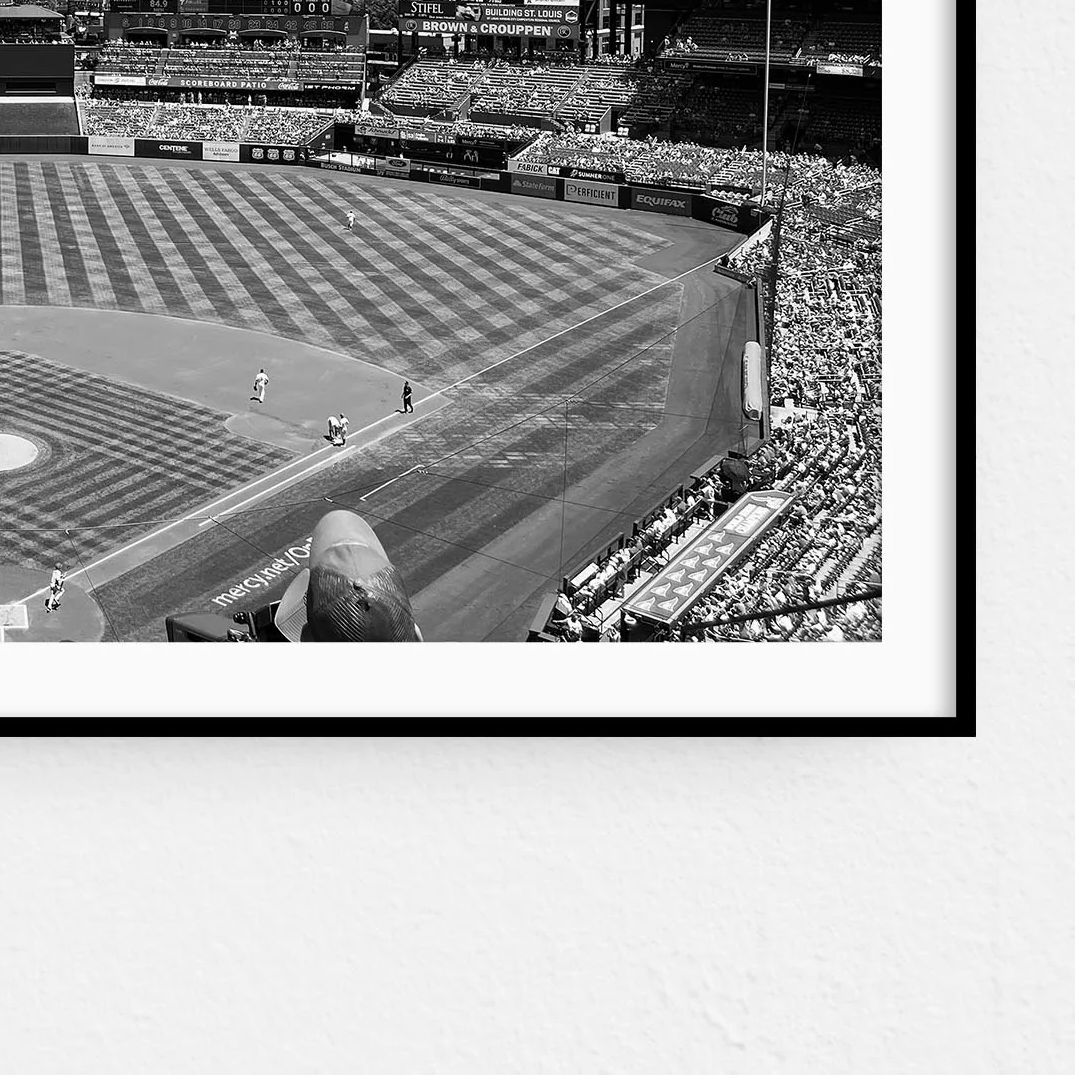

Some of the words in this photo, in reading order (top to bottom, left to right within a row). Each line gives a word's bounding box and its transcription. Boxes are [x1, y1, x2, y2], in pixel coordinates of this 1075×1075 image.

[150, 0, 168, 8] 84.9
[294, 3, 301, 13] 0
[308, 3, 315, 13] 0
[322, 3, 329, 13] 0
[411, 1, 444, 14] STIFEL
[485, 8, 523, 17] BUILDING
[524, 9, 536, 17] ST.
[537, 10, 562, 18] LOUIS
[422, 21, 468, 33] BROWN
[470, 24, 478, 33] &
[480, 23, 552, 36] CROUPPEN
[670, 62, 686, 70] Mercy
[180, 79, 238, 88] SCOREBOARD
[240, 81, 267, 89] PATIO
[320, 162, 337, 170] BUSCH
[338, 164, 361, 173] STADIUM
[517, 163, 544, 173] FABICK
[548, 166, 560, 175] CAT
[566, 185, 616, 200] PERFICIENT
[636, 194, 686, 208] EQUIFAX
